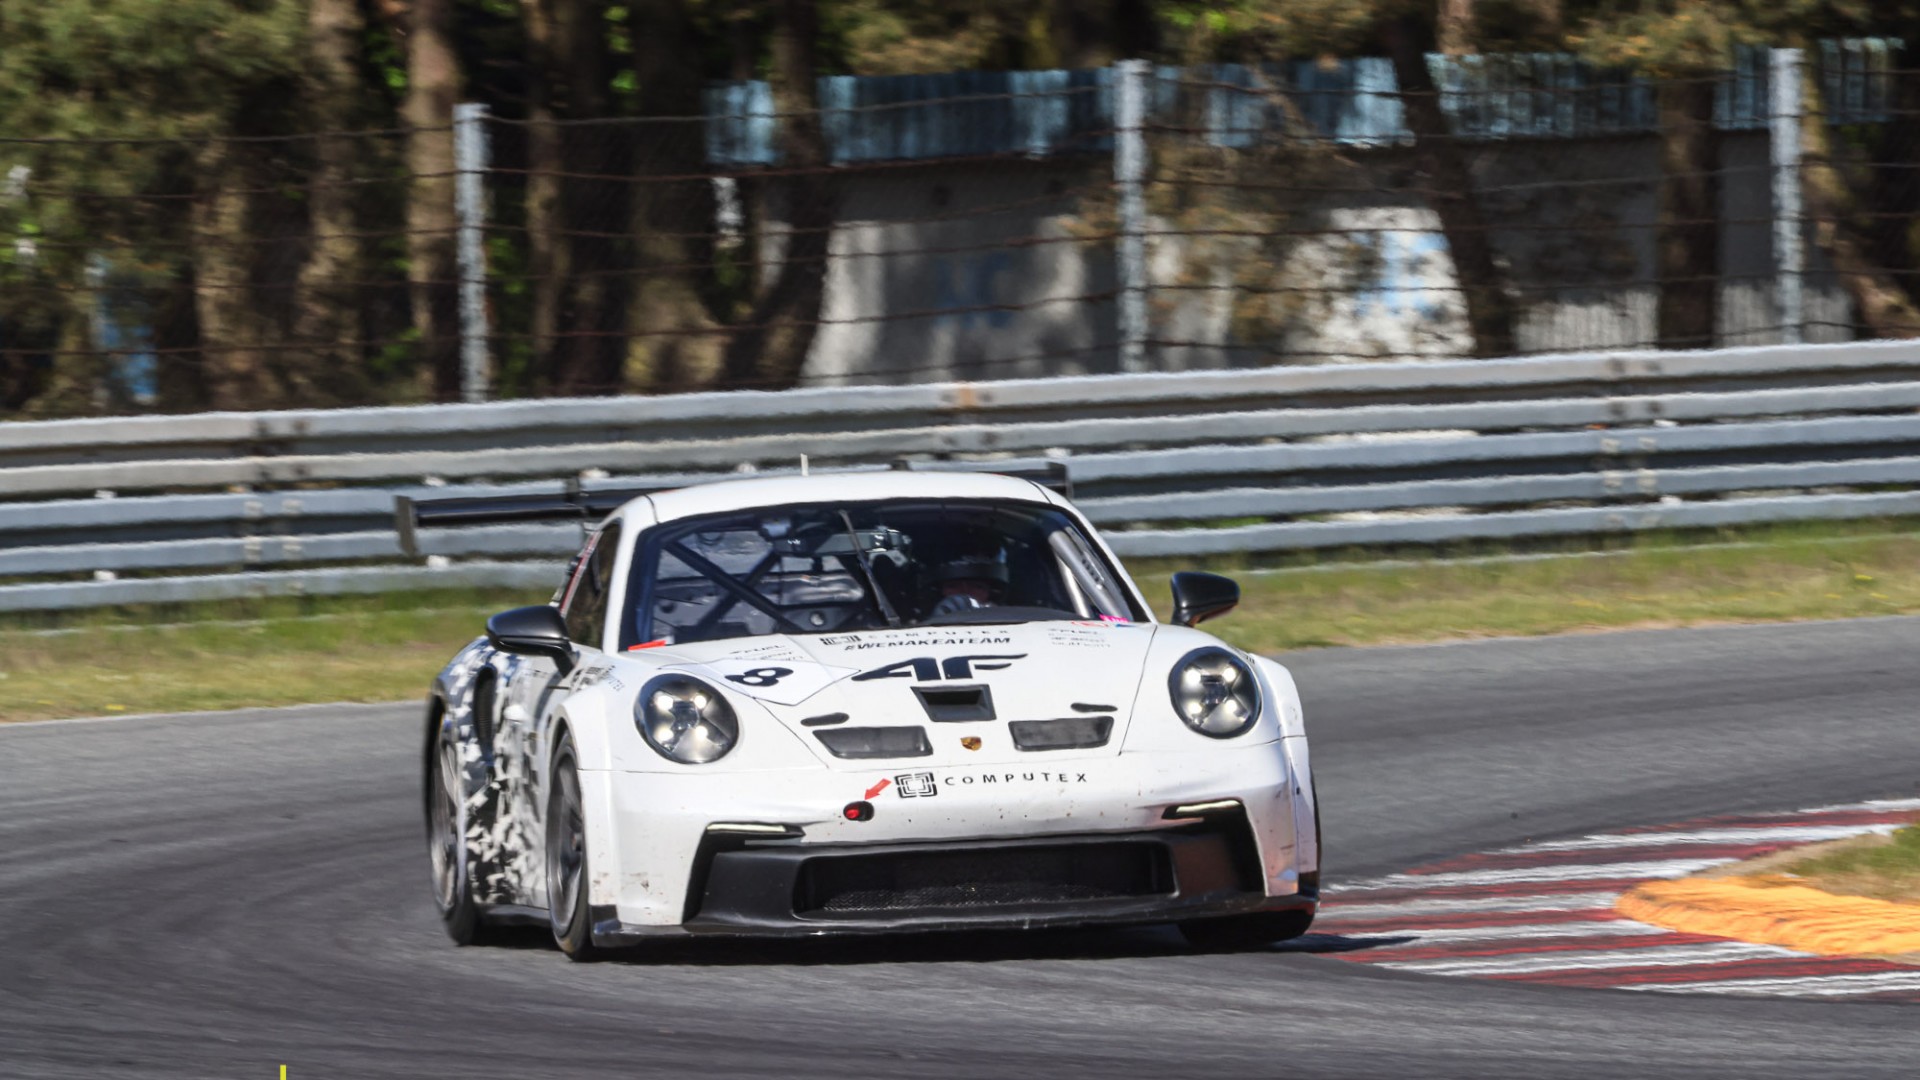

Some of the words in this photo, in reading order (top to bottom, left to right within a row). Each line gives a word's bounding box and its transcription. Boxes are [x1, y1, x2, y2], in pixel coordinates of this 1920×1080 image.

[844, 637, 1011, 651] #WEMAKEATEAM
[724, 667, 794, 687] 8
[944, 772, 1087, 786] COMPUTEX
